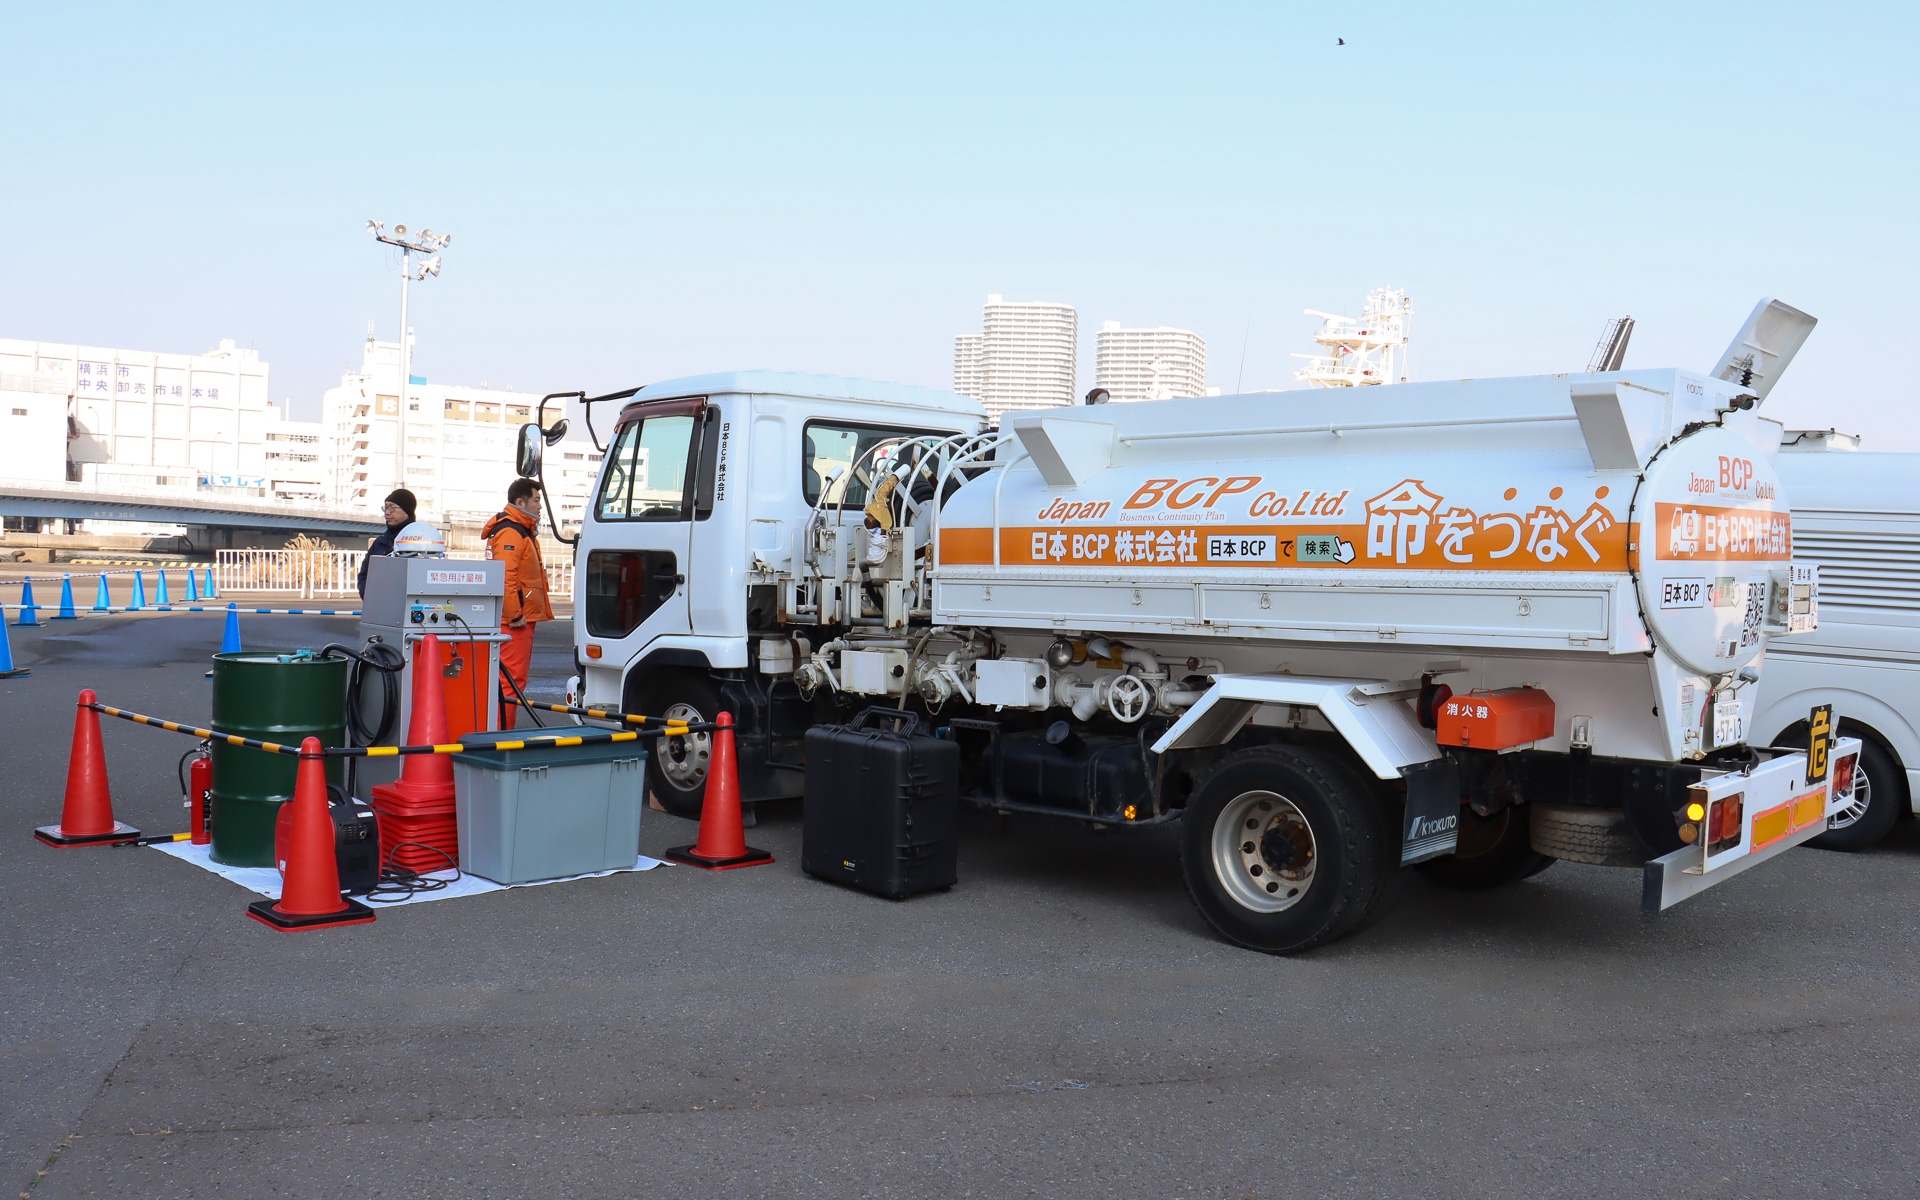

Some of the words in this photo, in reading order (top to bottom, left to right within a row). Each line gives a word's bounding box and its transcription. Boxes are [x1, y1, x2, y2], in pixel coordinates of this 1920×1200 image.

[79, 363, 130, 378] 横浜市
[79, 378, 219, 400] 中央卸売市場本場
[1688, 471, 1715, 497] Japan
[1718, 455, 1753, 491] BCP
[1755, 480, 1776, 501] Co.Ltd.
[1038, 497, 1111, 524] Japan
[1122, 476, 1262, 510] BCP
[1249, 490, 1349, 518] Co.Ltd.
[1119, 512, 1156, 521] Business
[1157, 511, 1204, 523] Continuity
[1205, 511, 1225, 521] Plan
[1365, 478, 1613, 564] 命をつなぐ
[1280, 541, 1294, 557] で
[1305, 540, 1330, 555] 検索
[430, 572, 484, 583] 緊急用計量機
[1706, 583, 1714, 602] で
[1446, 702, 1489, 719] 消火器
[1720, 717, 1742, 743] 57-13
[1807, 710, 1830, 778] 危
[1421, 815, 1457, 836] KYOKUTO
